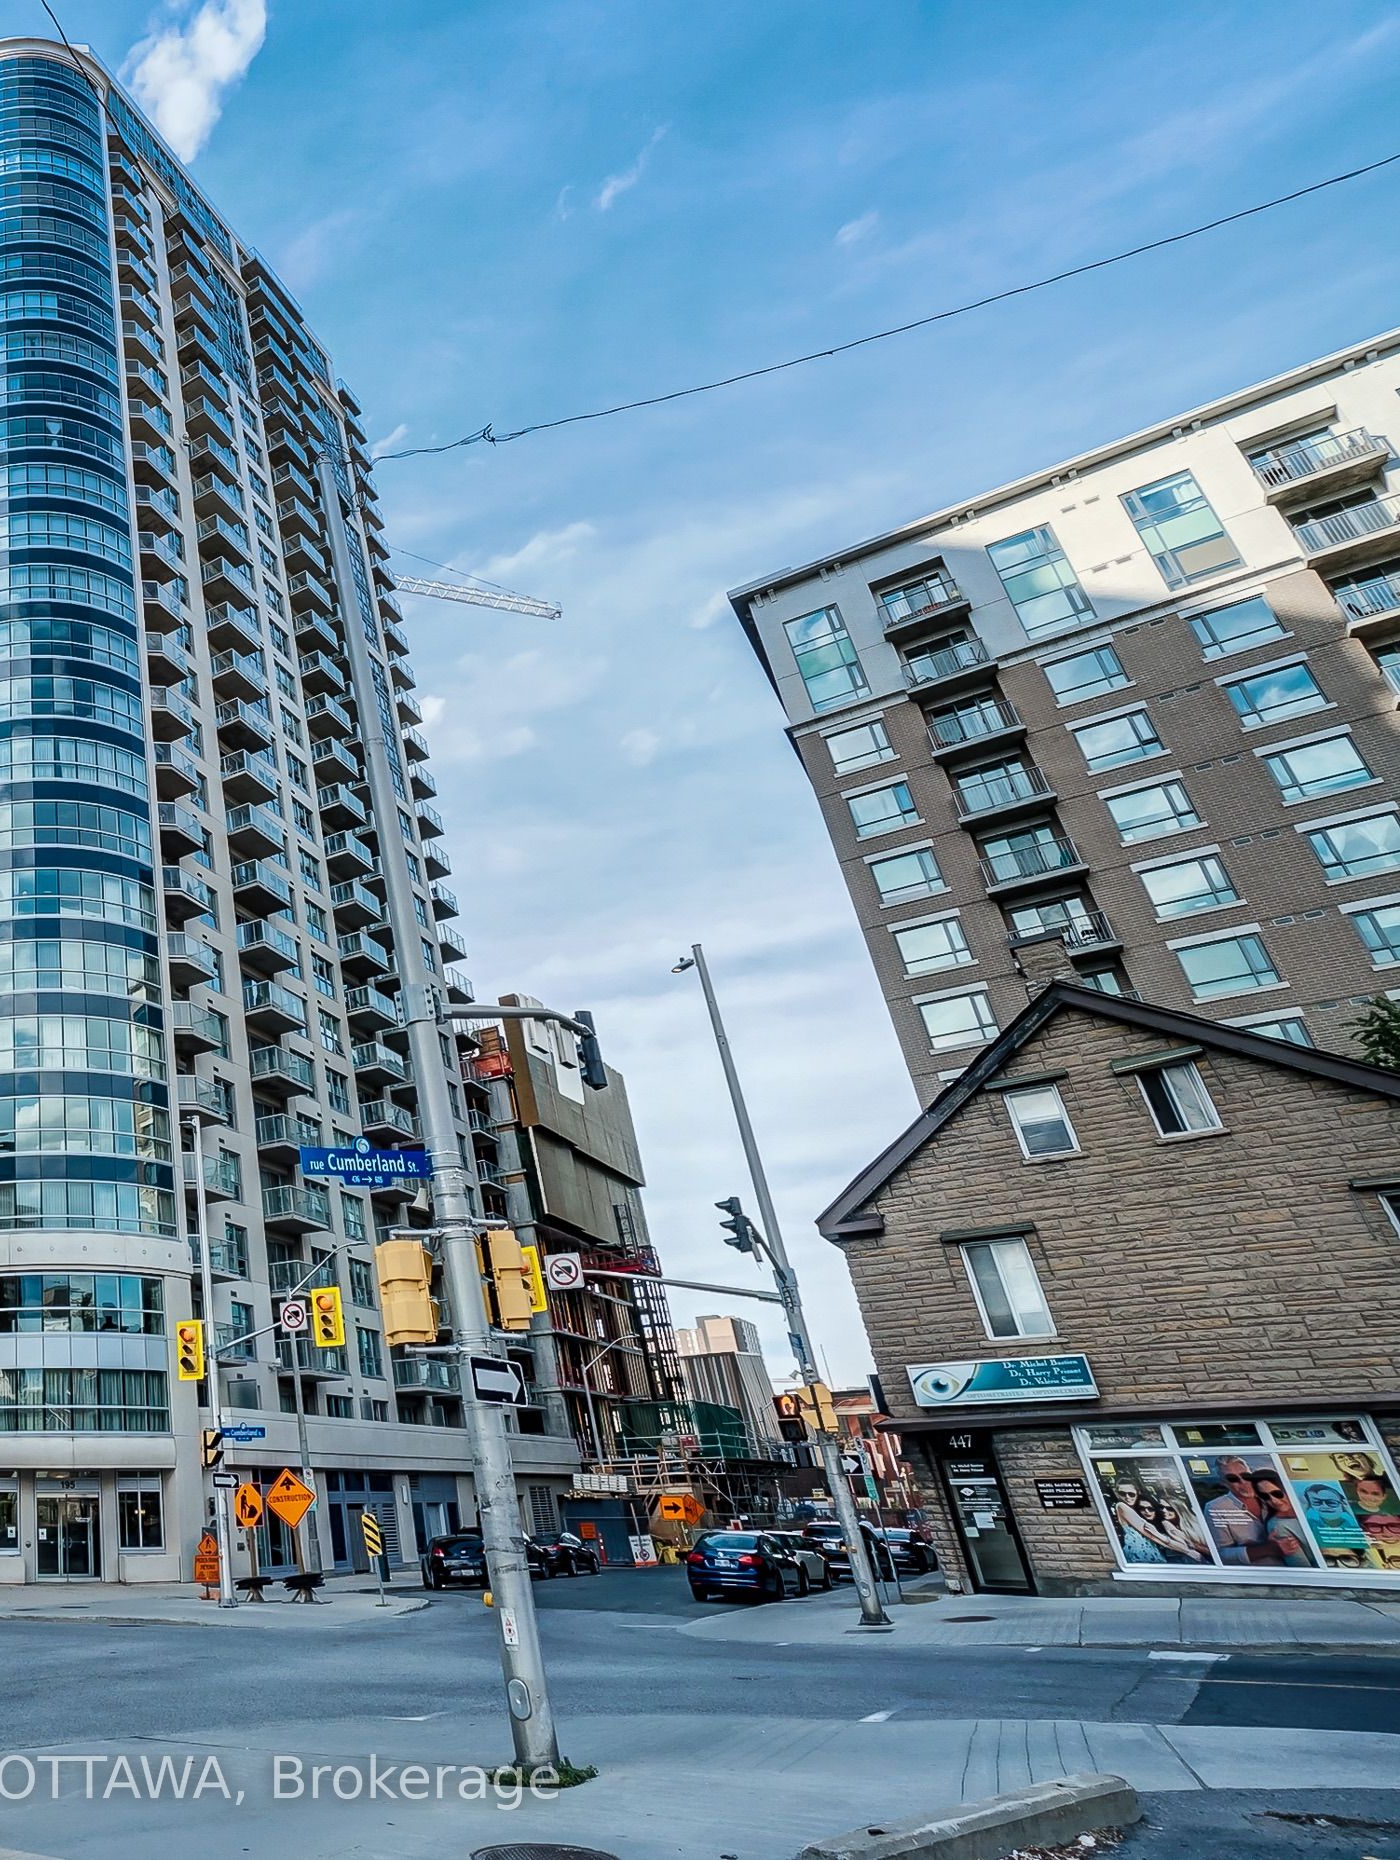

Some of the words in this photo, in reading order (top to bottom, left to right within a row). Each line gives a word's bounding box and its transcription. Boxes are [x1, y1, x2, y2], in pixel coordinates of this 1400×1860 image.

[310, 1161, 324, 1170] rue
[327, 1153, 406, 1172] Cumberland
[407, 1161, 420, 1173] St.
[1025, 1368, 1050, 1377] Harry
[949, 1434, 972, 1449] 447
[61, 1480, 76, 1489] 195
[269, 1493, 312, 1503] CONSTRUCTION
